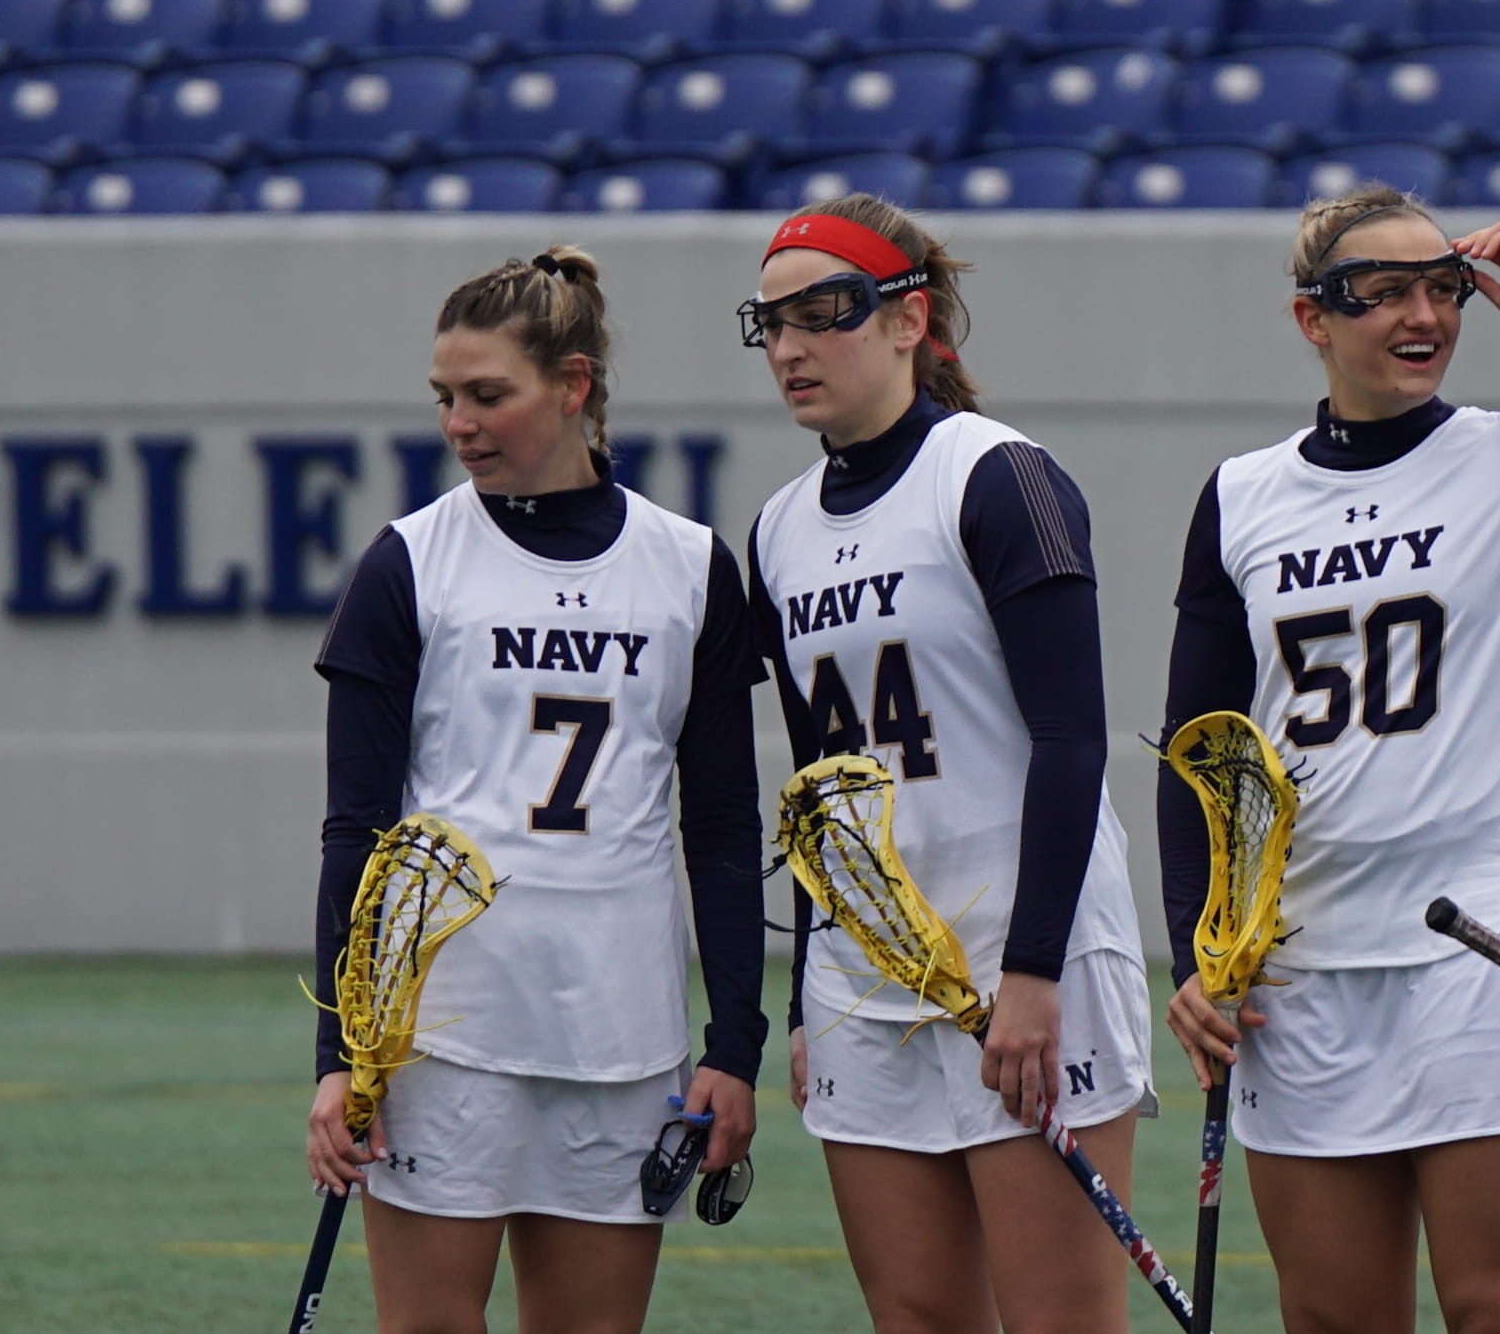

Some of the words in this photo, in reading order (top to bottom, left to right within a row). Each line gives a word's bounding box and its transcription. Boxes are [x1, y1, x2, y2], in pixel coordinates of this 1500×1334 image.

[787, 571, 904, 639] NAVY
[1278, 525, 1444, 594] NAVY
[491, 626, 649, 677] NAVY
[1273, 592, 1448, 748] 50
[807, 639, 942, 783] 44
[527, 693, 614, 835] 7
